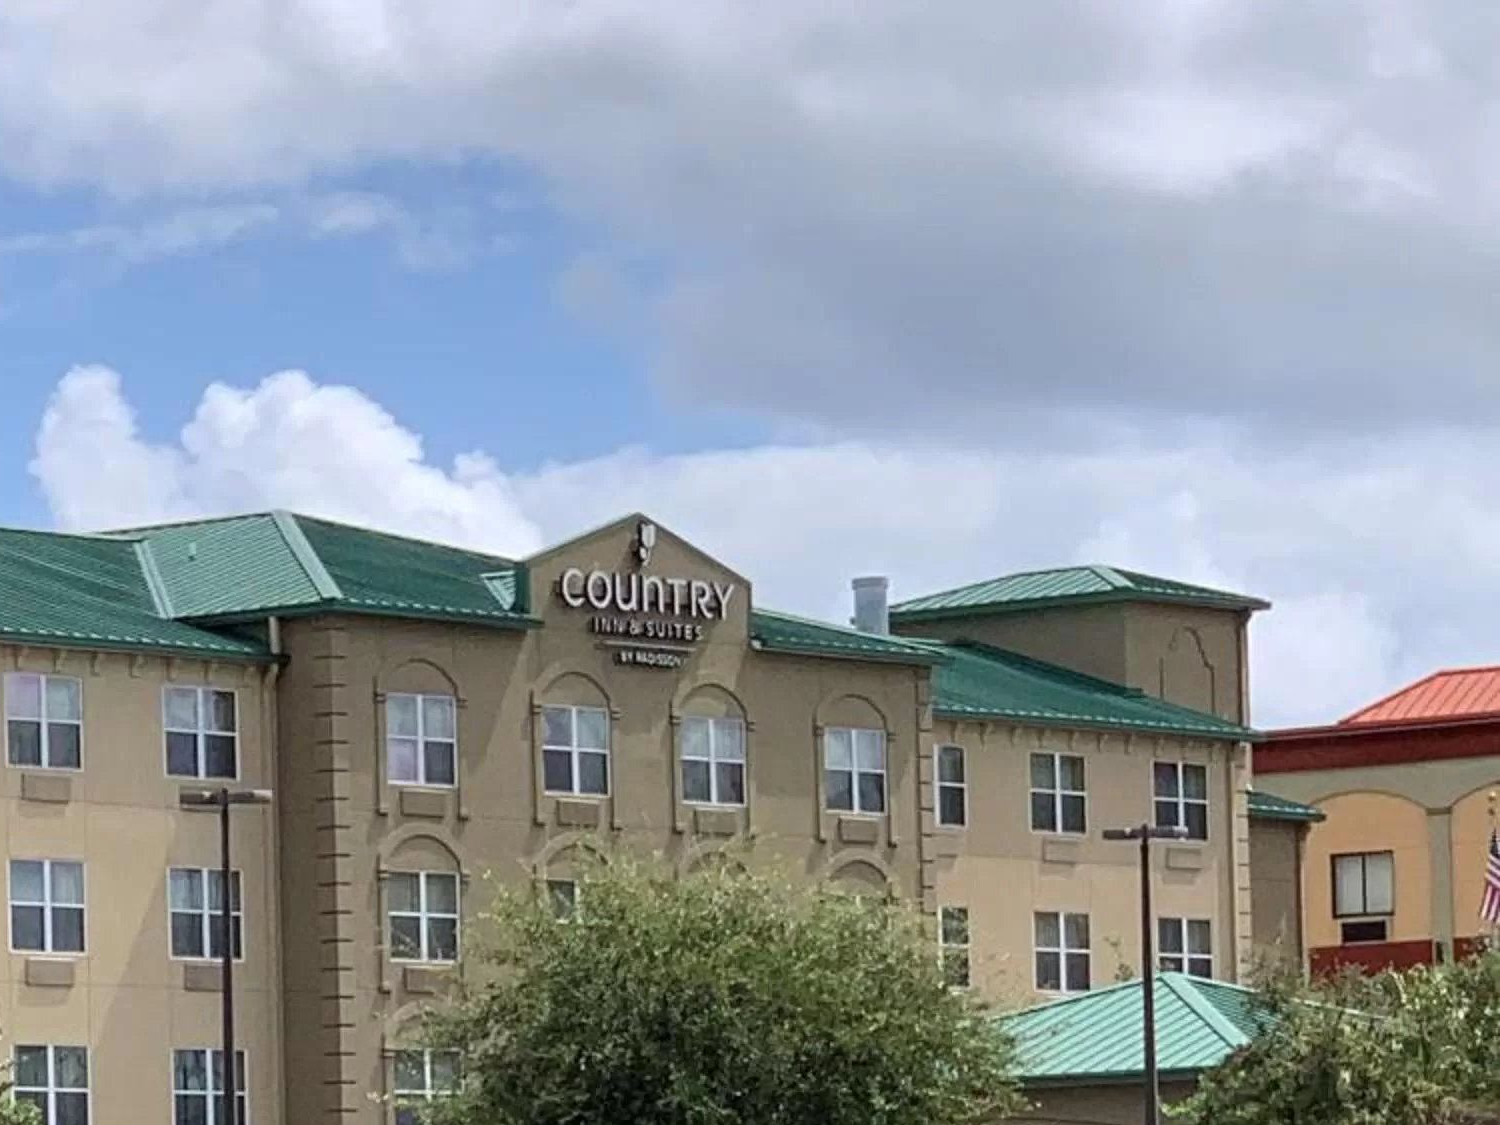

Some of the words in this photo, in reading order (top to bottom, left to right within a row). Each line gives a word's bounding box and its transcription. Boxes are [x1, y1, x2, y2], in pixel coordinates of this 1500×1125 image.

[593, 617, 625, 633] INN
[629, 619, 642, 635] &
[645, 620, 704, 640] SUITES
